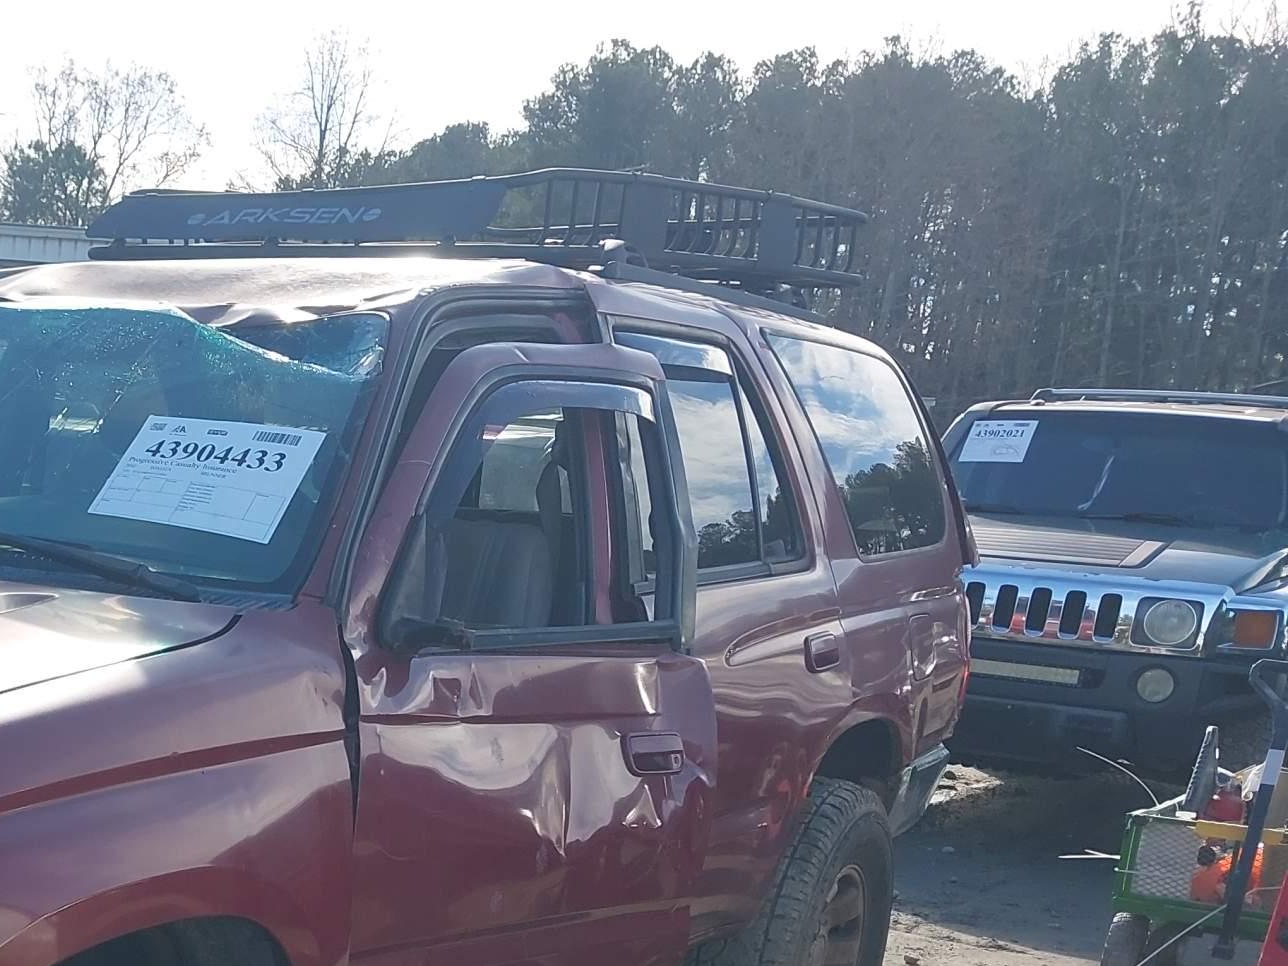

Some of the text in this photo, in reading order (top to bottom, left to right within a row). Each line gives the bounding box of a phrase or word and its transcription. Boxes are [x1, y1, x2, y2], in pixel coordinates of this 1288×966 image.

[202, 207, 363, 226] ARKSEN
[975, 429, 1025, 438] 43902021
[145, 439, 287, 473] 43904433
